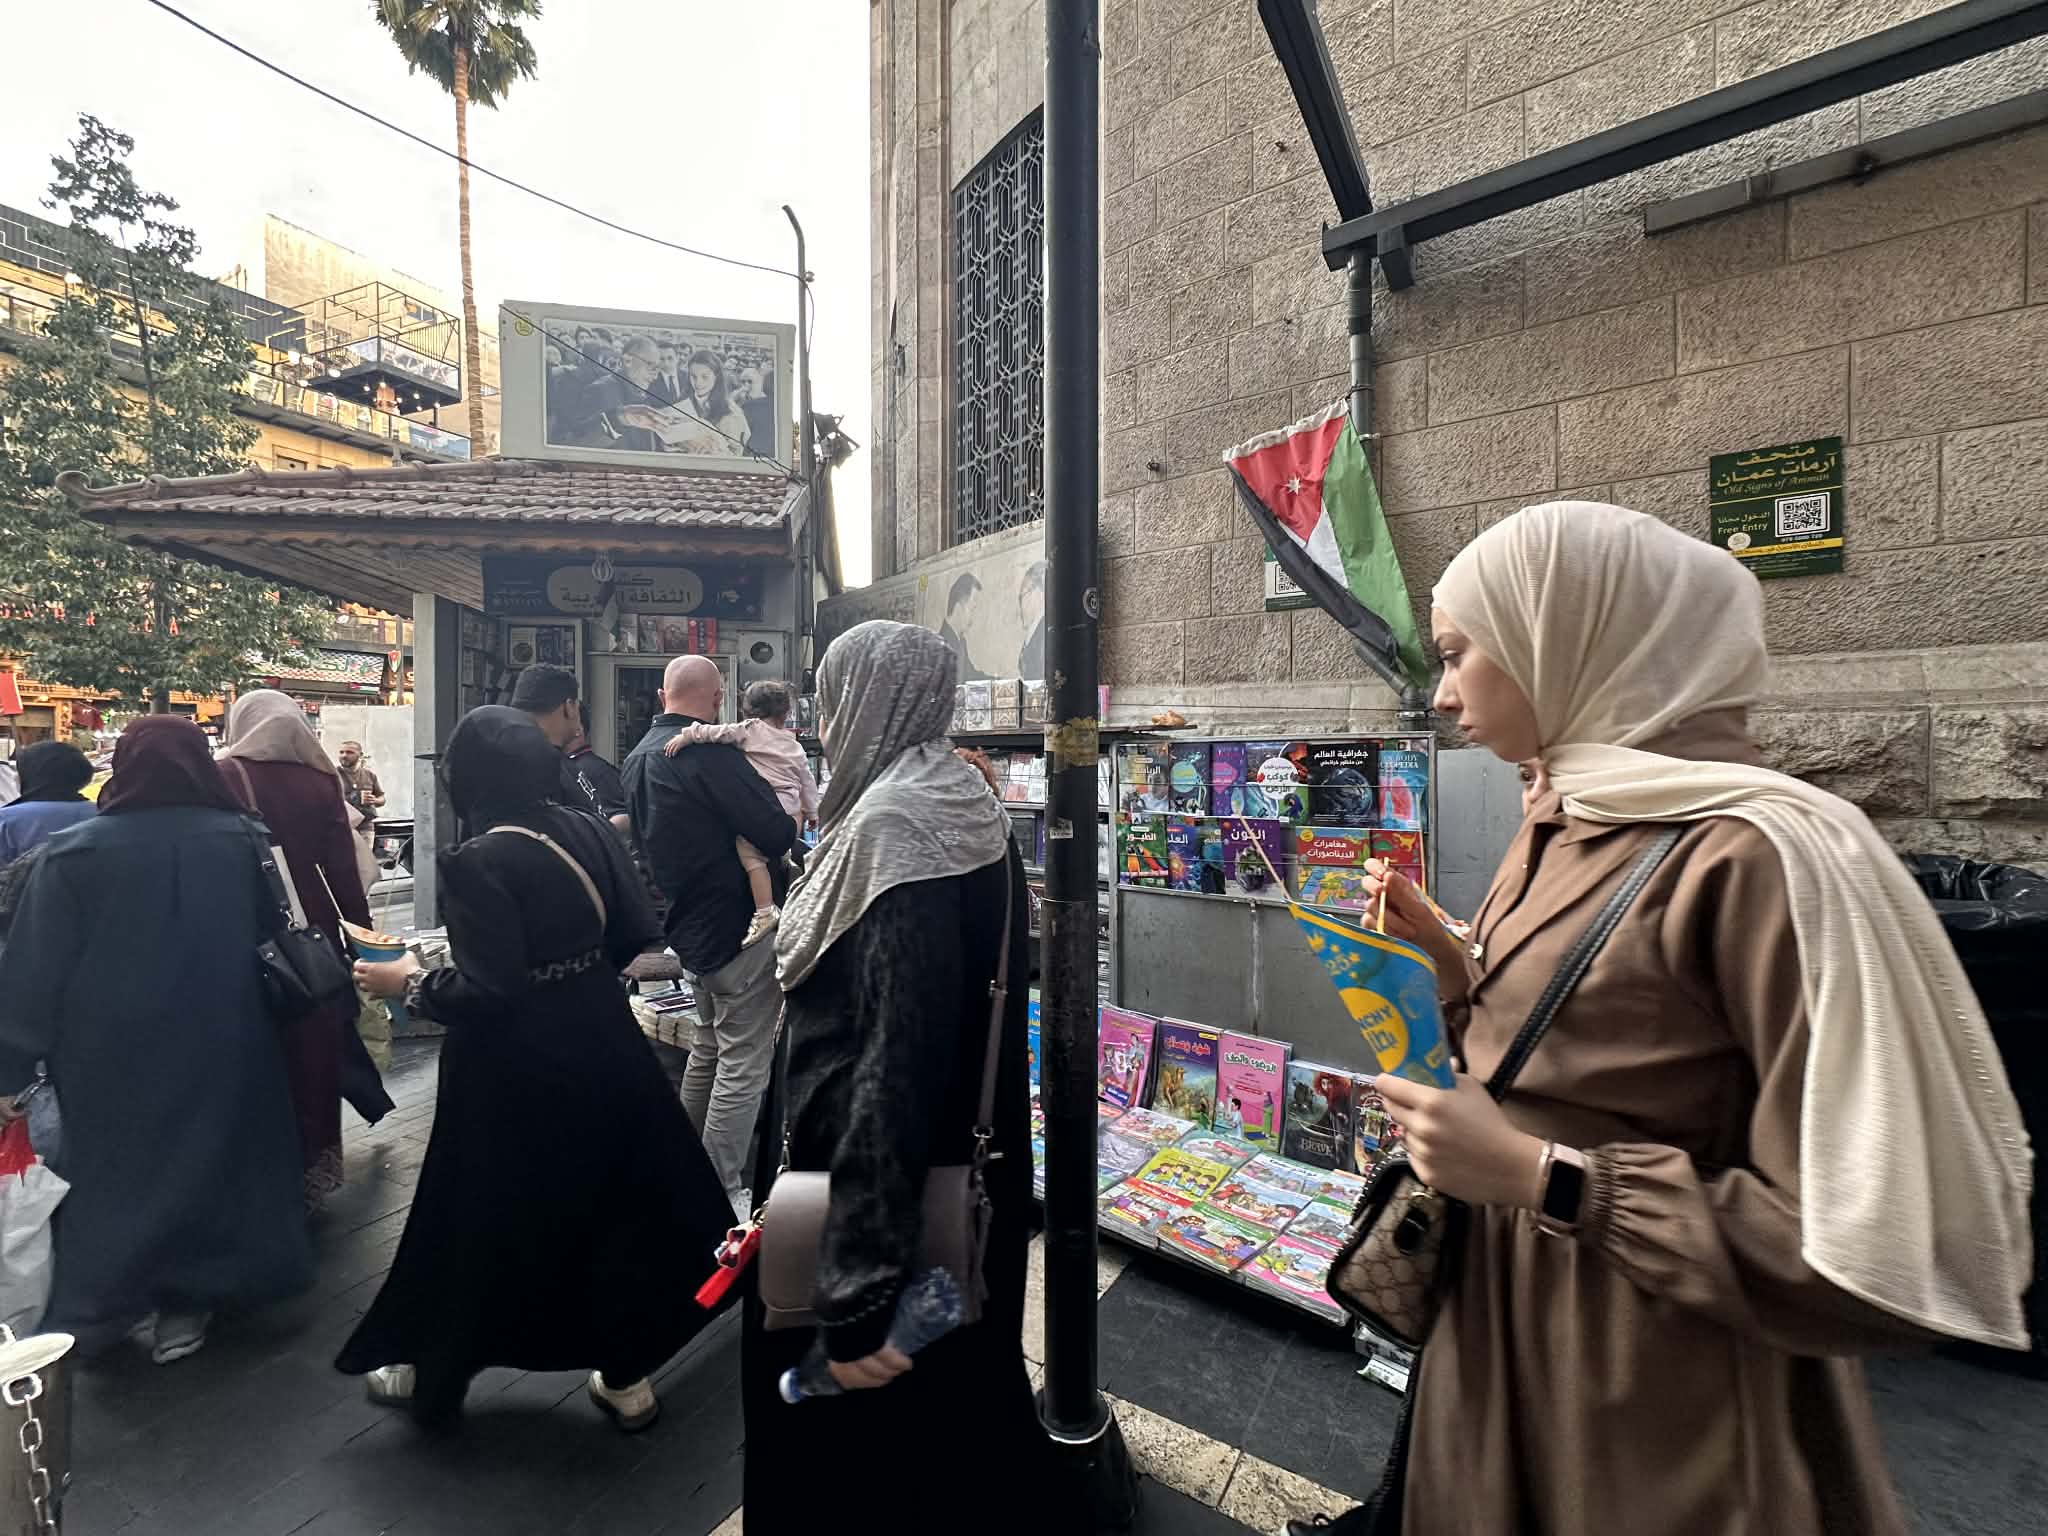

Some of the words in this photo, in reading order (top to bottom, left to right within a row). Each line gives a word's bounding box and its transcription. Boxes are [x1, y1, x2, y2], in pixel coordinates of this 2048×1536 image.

[1736, 445, 1816, 467] متحف
[1780, 451, 1838, 476] آرمات
[1716, 467, 1776, 488] عمان
[1723, 485, 1742, 496] Old
[1743, 482, 1772, 495] Signs
[1774, 477, 1786, 491] of
[1789, 473, 1830, 486] Amman
[1717, 526, 1740, 536] Free
[1742, 522, 1769, 533] Entry
[629, 587, 691, 604] الثقافة
[1314, 750, 1337, 760] العالم
[1337, 749, 1369, 759] جغرافية
[1266, 773, 1289, 782] كوكب
[1126, 832, 1157, 842] الطيور
[1230, 828, 1266, 841] الكون
[1313, 839, 1347, 848] مغامرات
[1306, 849, 1355, 860] الديناصورات
[1300, 1137, 1334, 1156] BRAVE
